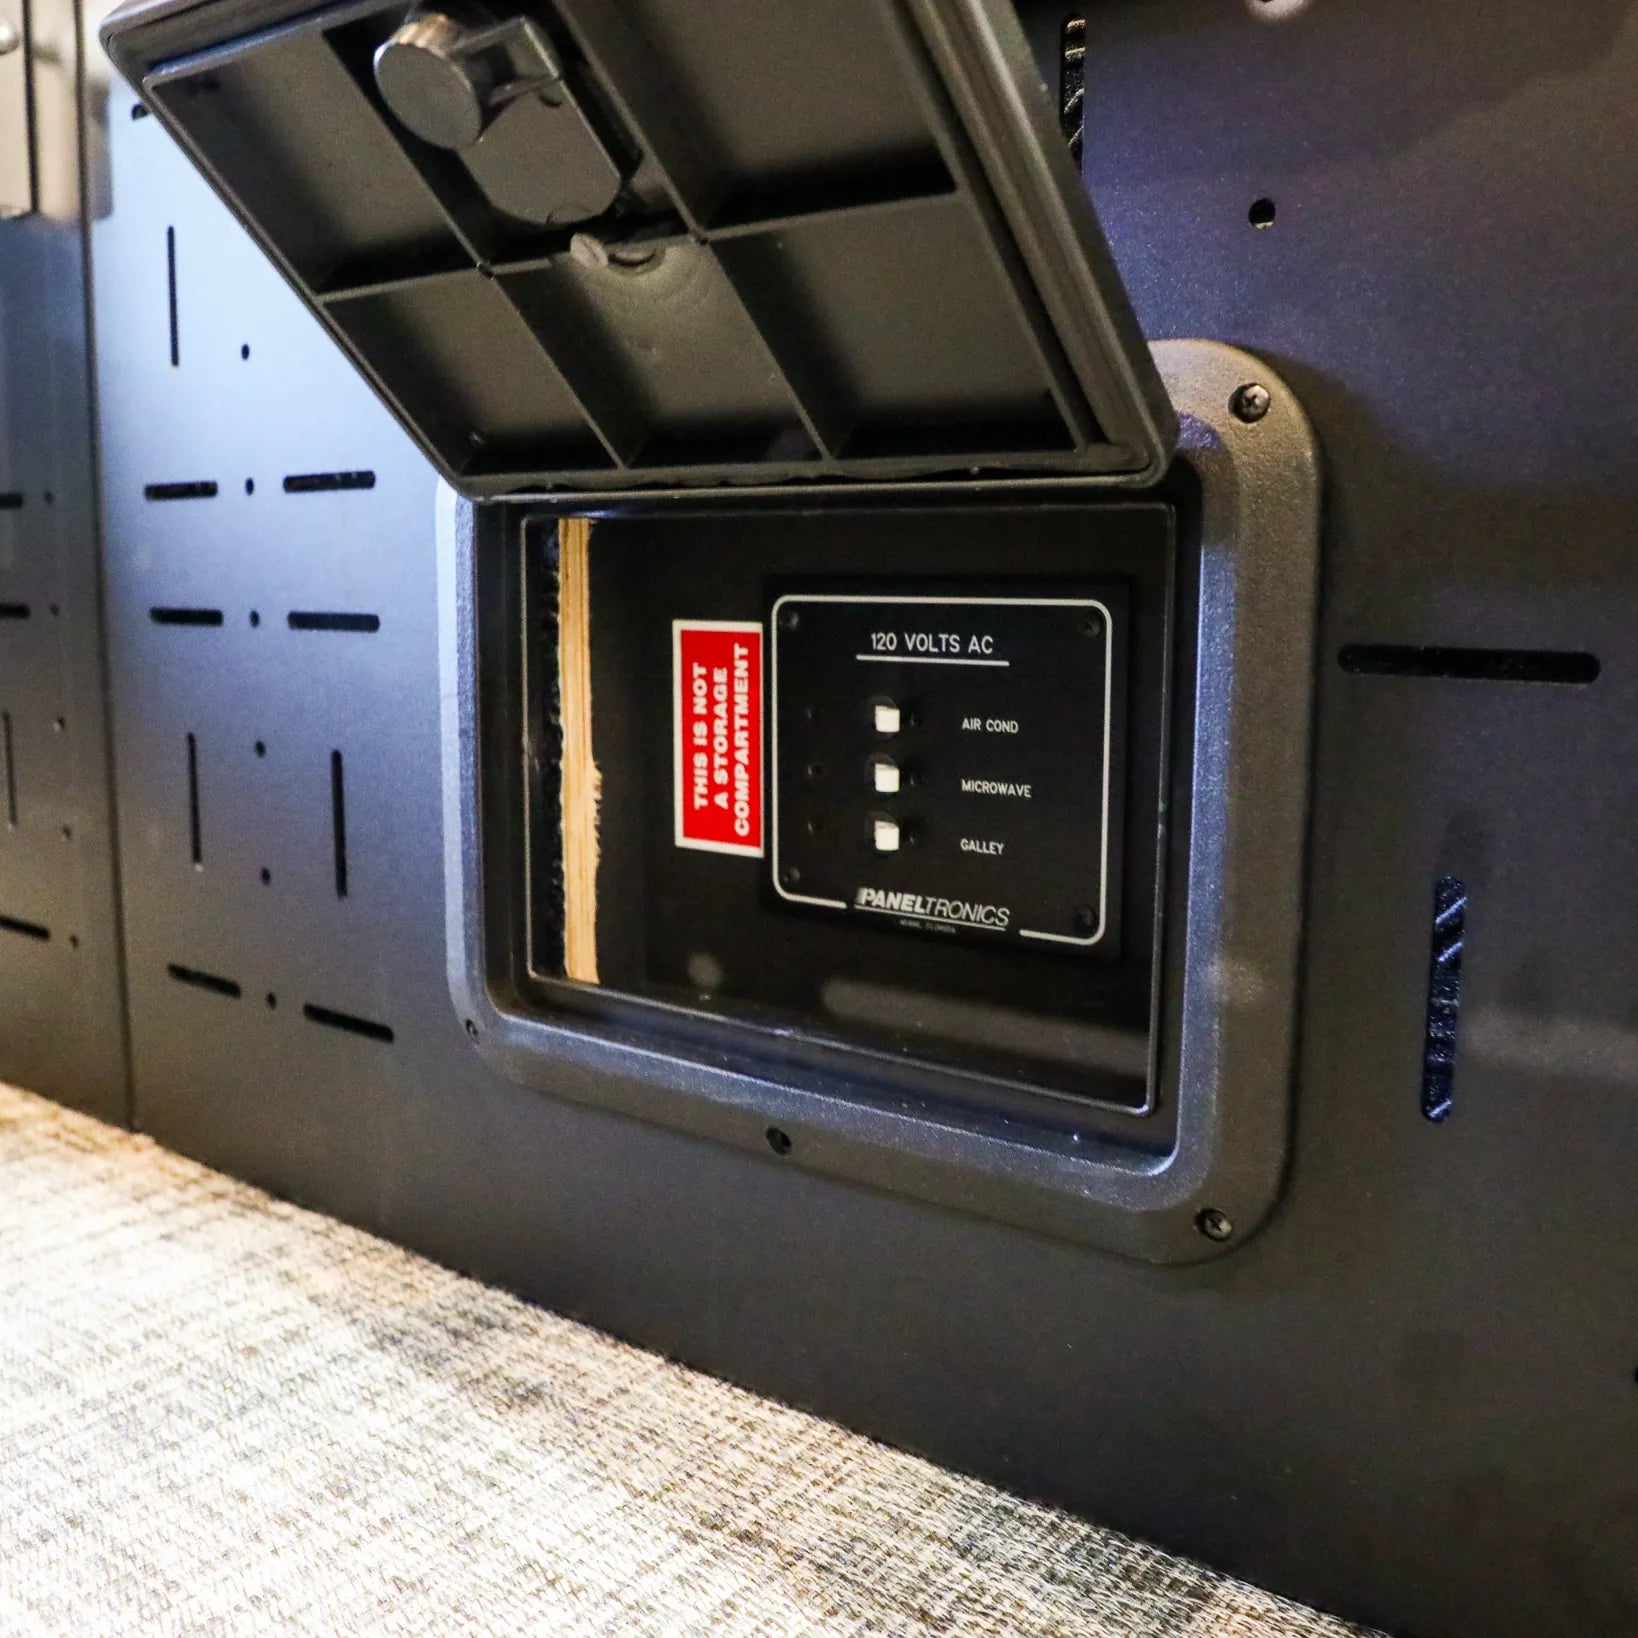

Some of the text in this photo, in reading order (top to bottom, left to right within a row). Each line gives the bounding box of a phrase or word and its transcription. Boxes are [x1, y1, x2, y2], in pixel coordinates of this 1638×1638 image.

[871, 632, 994, 654] 120 VOLTS AC
[693, 662, 708, 810] THIS IS NOT
[713, 667, 729, 809] A STORAGE
[734, 643, 750, 836] COMPARTMENT
[961, 717, 1019, 734] AIR COND
[961, 779, 1032, 798] MICROWAVE
[960, 838, 1004, 855] GALLEY
[856, 886, 1010, 927] PANELTRONICS
